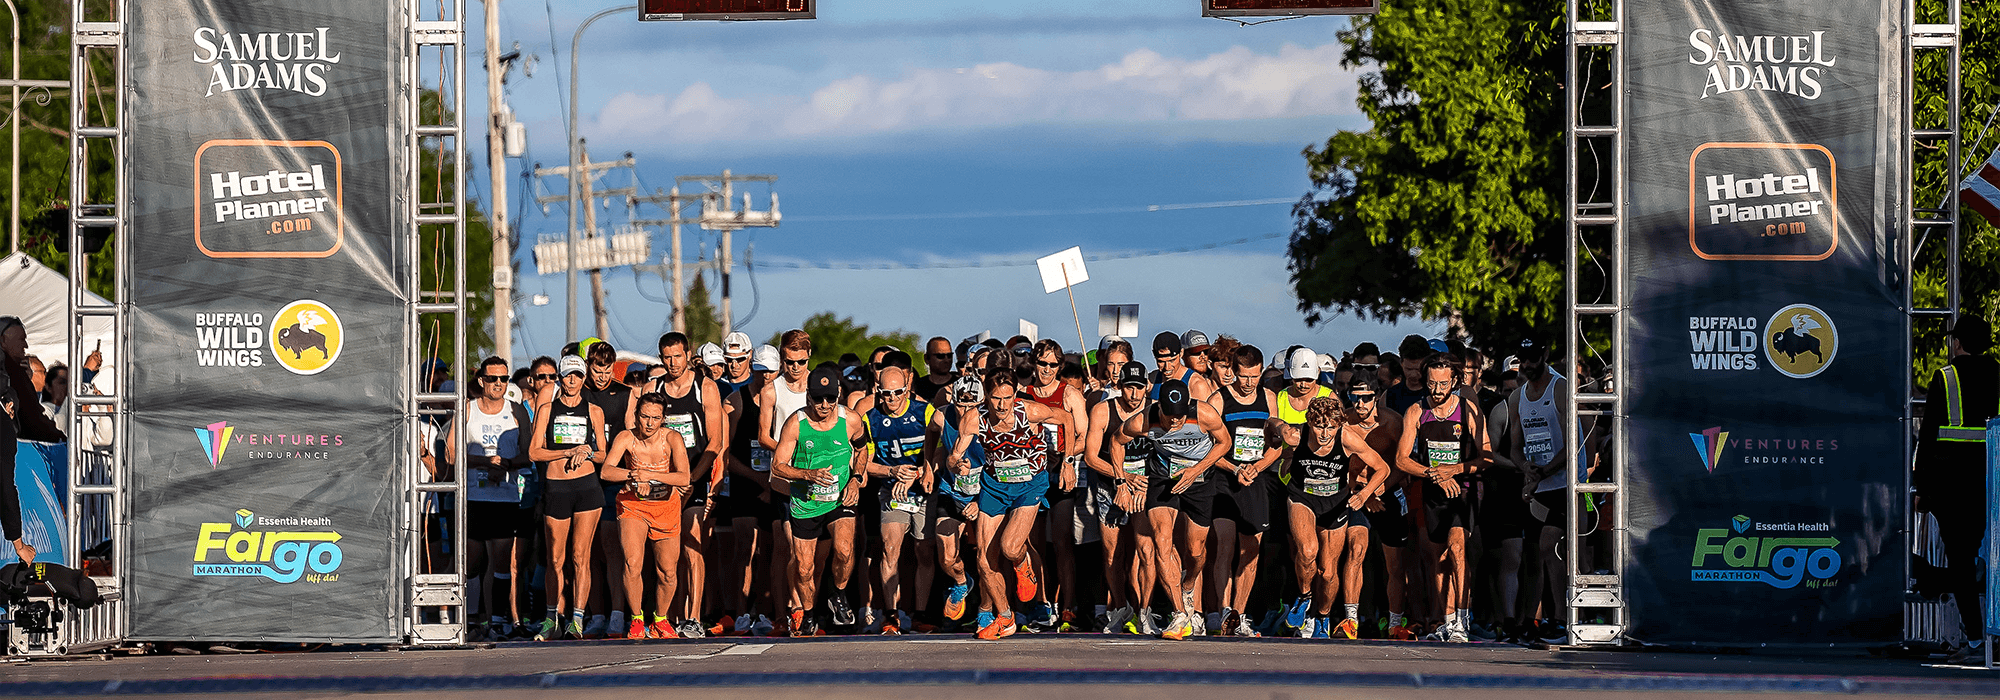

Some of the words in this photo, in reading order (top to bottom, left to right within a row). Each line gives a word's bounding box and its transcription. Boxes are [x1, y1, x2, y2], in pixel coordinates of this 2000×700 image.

[193, 27, 341, 64] SAMUEL
[1689, 28, 1836, 67] SAMUEL
[205, 62, 327, 98] ADAMS
[1700, 64, 1822, 100] ADAMS
[210, 164, 326, 199] Hotel
[1705, 167, 1821, 201] Hotel
[214, 196, 328, 222] Planner
[1709, 199, 1823, 225] Planner
[266, 217, 312, 235] .com
[1760, 221, 1806, 237] .com
[195, 313, 263, 326] BUFFALO
[1689, 316, 1757, 330] BUFFALO
[195, 326, 263, 349] WILD
[1689, 330, 1758, 353] WILD
[196, 349, 263, 367] WINGS
[1690, 353, 1757, 370] WINGS
[481, 424, 503, 434] BIG
[235, 434, 344, 446] VENTURES
[1528, 442, 1552, 454] 20584
[1730, 438, 1838, 450] VENTURES
[248, 451, 329, 460] ENDURANCE
[1430, 451, 1459, 460] 22204
[1744, 456, 1825, 465] ENDURANCE
[997, 467, 1030, 477] 21530
[258, 516, 298, 526] Essentia
[300, 516, 332, 526] Health
[1755, 522, 1796, 531] Essentia
[1797, 522, 1829, 532] Health
[193, 522, 343, 584] Fargo
[1692, 528, 1842, 589] Fargo
[196, 565, 262, 575] MARATHON
[1694, 571, 1760, 580] MARATHON
